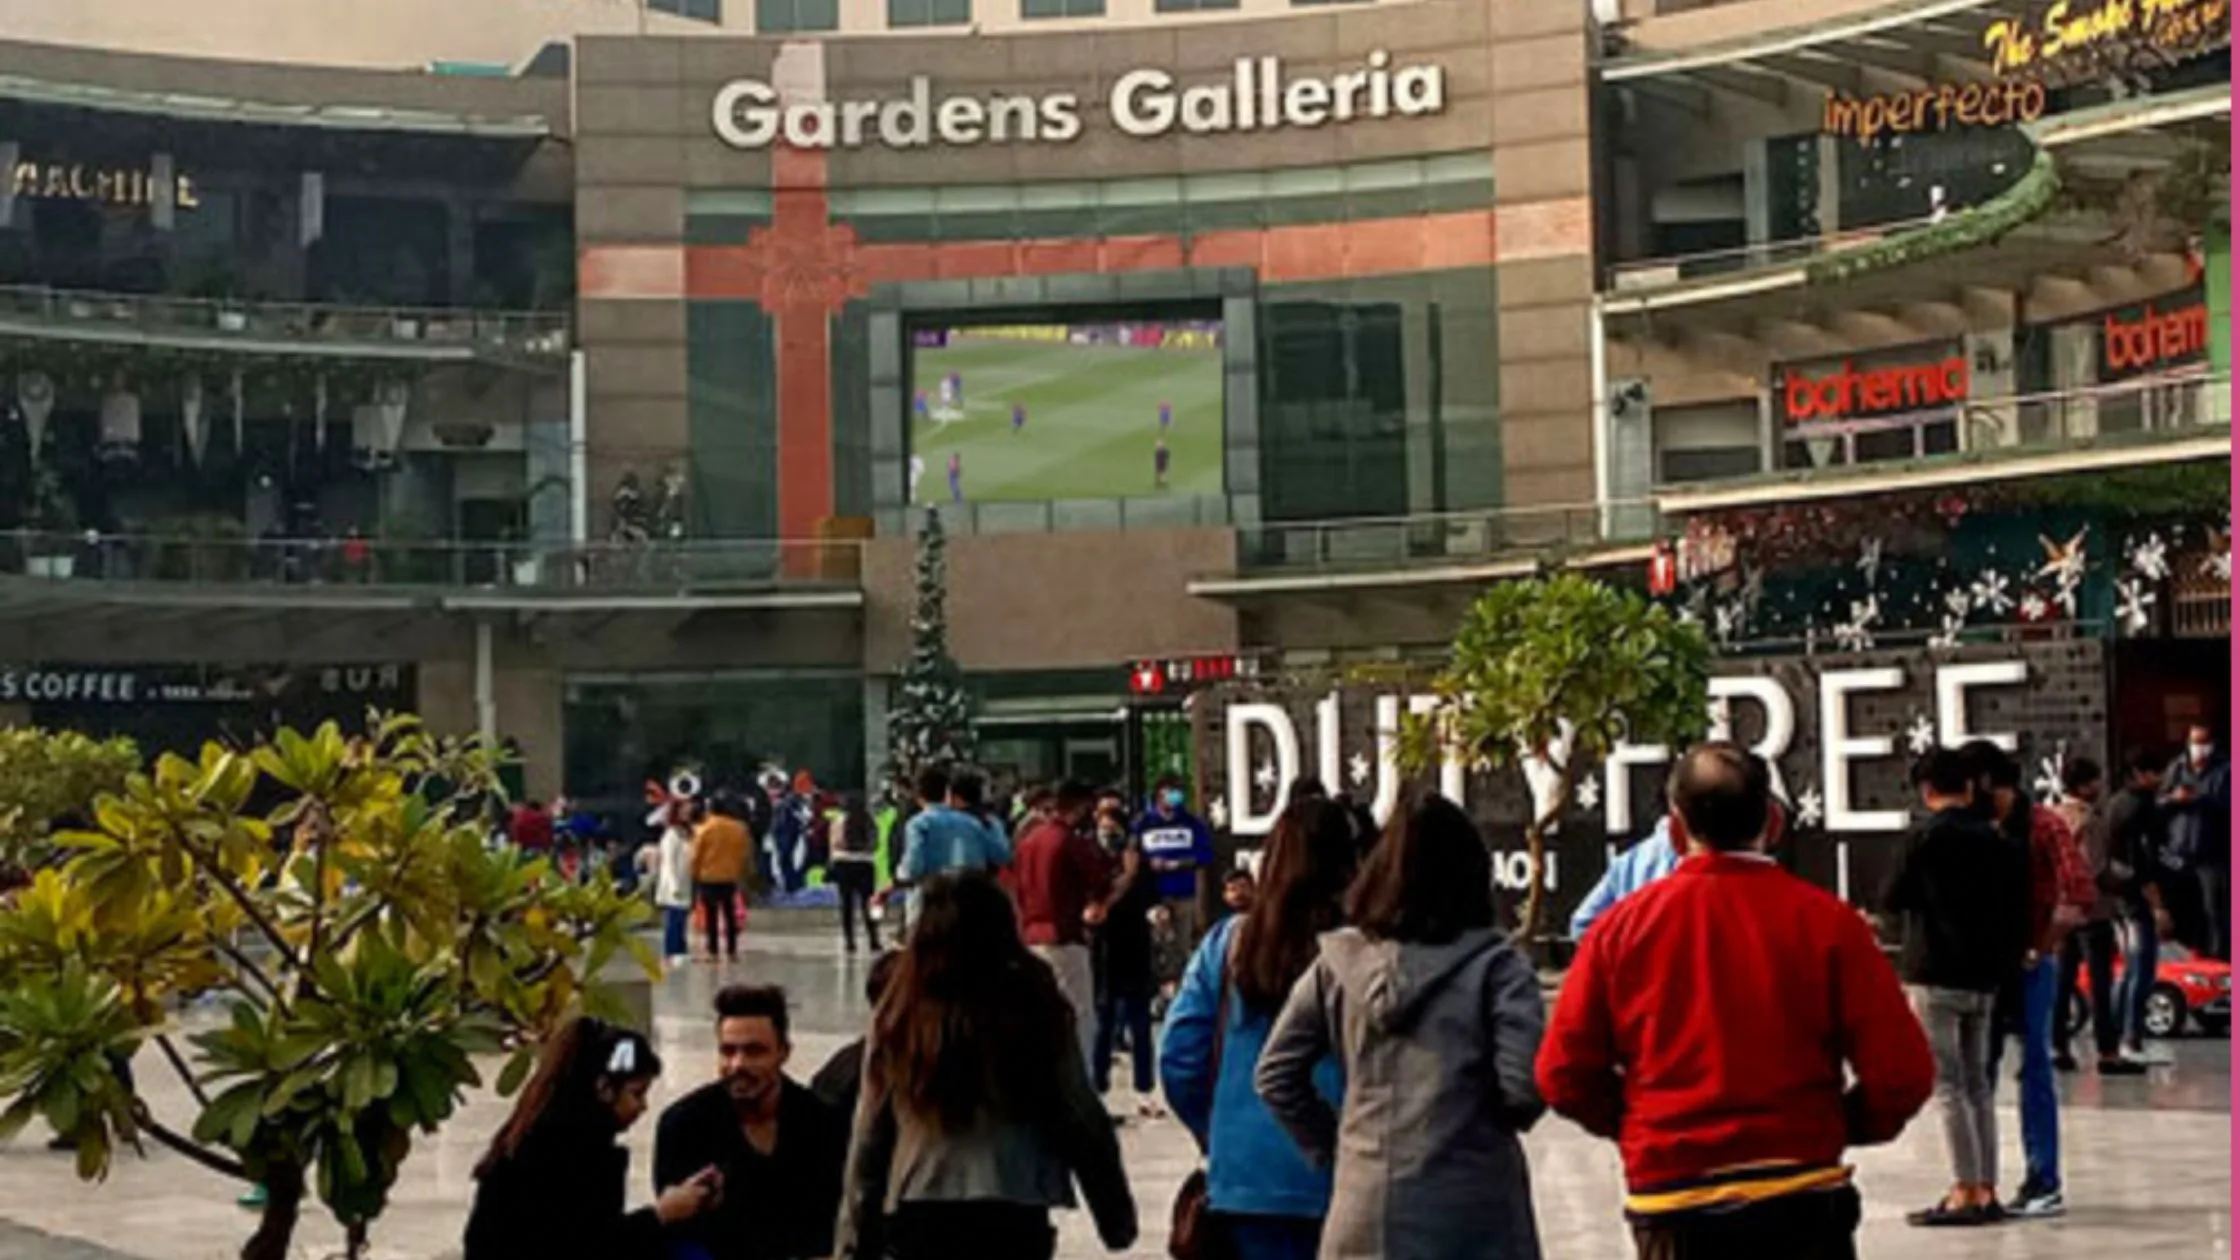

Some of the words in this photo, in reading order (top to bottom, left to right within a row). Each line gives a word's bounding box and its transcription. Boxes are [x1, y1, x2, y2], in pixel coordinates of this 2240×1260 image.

[712, 75, 1081, 148] Gardens
[1110, 49, 1444, 136] Galleria
[1824, 78, 2045, 148] imperfecto
[1786, 356, 1968, 421] bohemia
[25, 673, 135, 701] COFFEE
